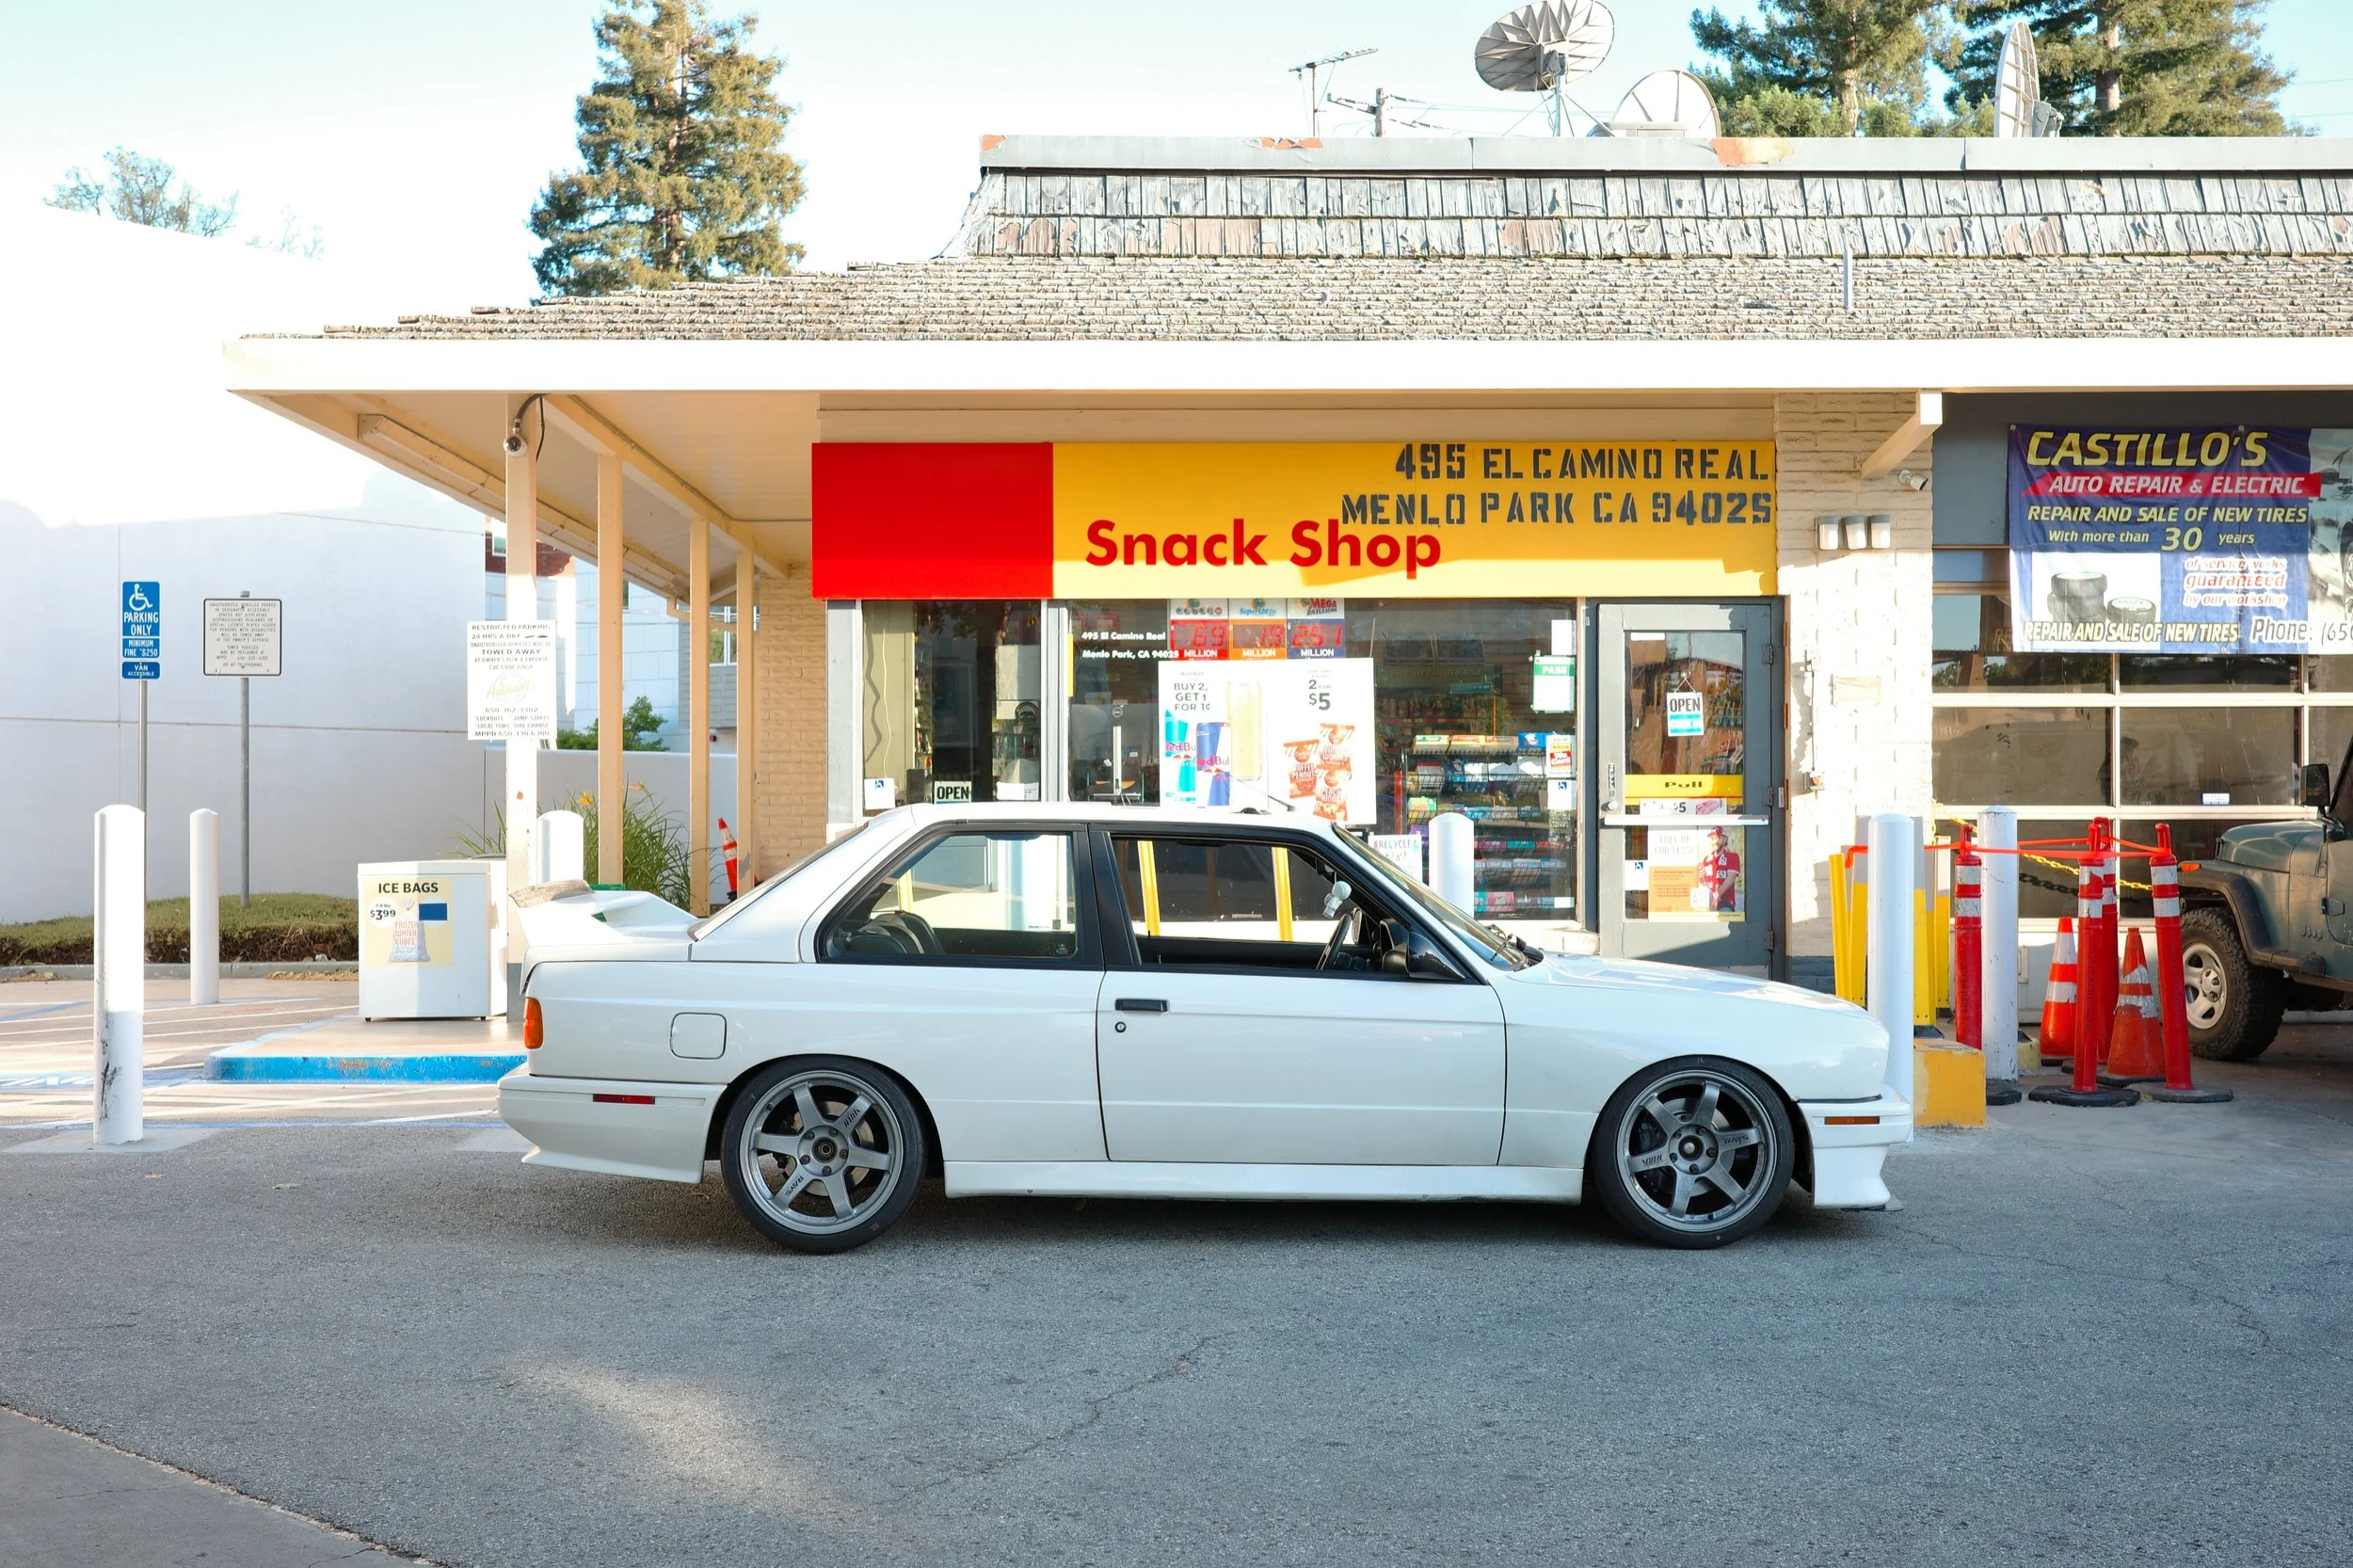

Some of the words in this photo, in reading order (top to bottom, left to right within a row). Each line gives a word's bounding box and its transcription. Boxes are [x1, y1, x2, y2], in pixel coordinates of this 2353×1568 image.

[2026, 432, 2268, 466] CASTILLO'S
[1396, 443, 1465, 480] 495
[1483, 448, 1523, 479] EL
[1533, 448, 1662, 479] CAMINO
[1675, 449, 1769, 480] REAL
[2049, 476, 2103, 493] AUTO
[2109, 476, 2183, 493] REPAIR
[2189, 476, 2202, 493] &
[2211, 476, 2305, 493] ELECTRIC
[1342, 494, 1465, 526] MENLO
[1481, 492, 1574, 523] PARK
[1593, 492, 1638, 523] CA
[2028, 507, 2090, 522] REPAIR
[2094, 507, 2131, 522] AND
[2137, 507, 2178, 522] SALE
[2185, 507, 2208, 522] OF
[2213, 507, 2252, 522] NEW
[2257, 507, 2307, 522] TIRES
[2049, 530, 2078, 542] With
[2082, 533, 2115, 542] more
[2119, 531, 2149, 542] than
[2161, 527, 2202, 551] 30
[2218, 533, 2255, 545] years
[1085, 519, 1268, 567] Snack
[1289, 519, 1441, 580] Shop
[2186, 574, 2285, 588] guaranteed
[1309, 598, 1337, 609] MEGA
[124, 612, 159, 623] PARKING
[131, 625, 152, 636] ONLY
[1101, 632, 1109, 640] El
[1111, 632, 1144, 640] Camino
[1192, 625, 1225, 646] 69
[1292, 625, 1342, 646] 251
[2024, 622, 2073, 642] REPAIR
[2074, 622, 2106, 642] AND
[2106, 622, 2141, 642] SALE
[2142, 622, 2163, 642] OF
[2165, 622, 2199, 642] NEW
[2199, 622, 2240, 642] TIRES
[2252, 619, 2313, 640] Phone:
[1082, 650, 1110, 658] Menlo
[1112, 650, 1135, 659] Park,
[1152, 650, 1179, 658] 94025
[1542, 665, 1568, 675] PASS
[1199, 683, 1208, 691] 2,
[1309, 679, 1317, 689] 2
[1175, 693, 1199, 701] GET
[1309, 693, 1330, 710] $5
[1670, 698, 1700, 712] OPEN
[936, 786, 970, 800] OPEN
[1673, 802, 1687, 813] $5
[379, 883, 399, 893] ICE
[403, 883, 438, 893] BAGS
[1725, 1135, 1749, 1144] RAYS
[784, 1176, 804, 1196] RAYS
